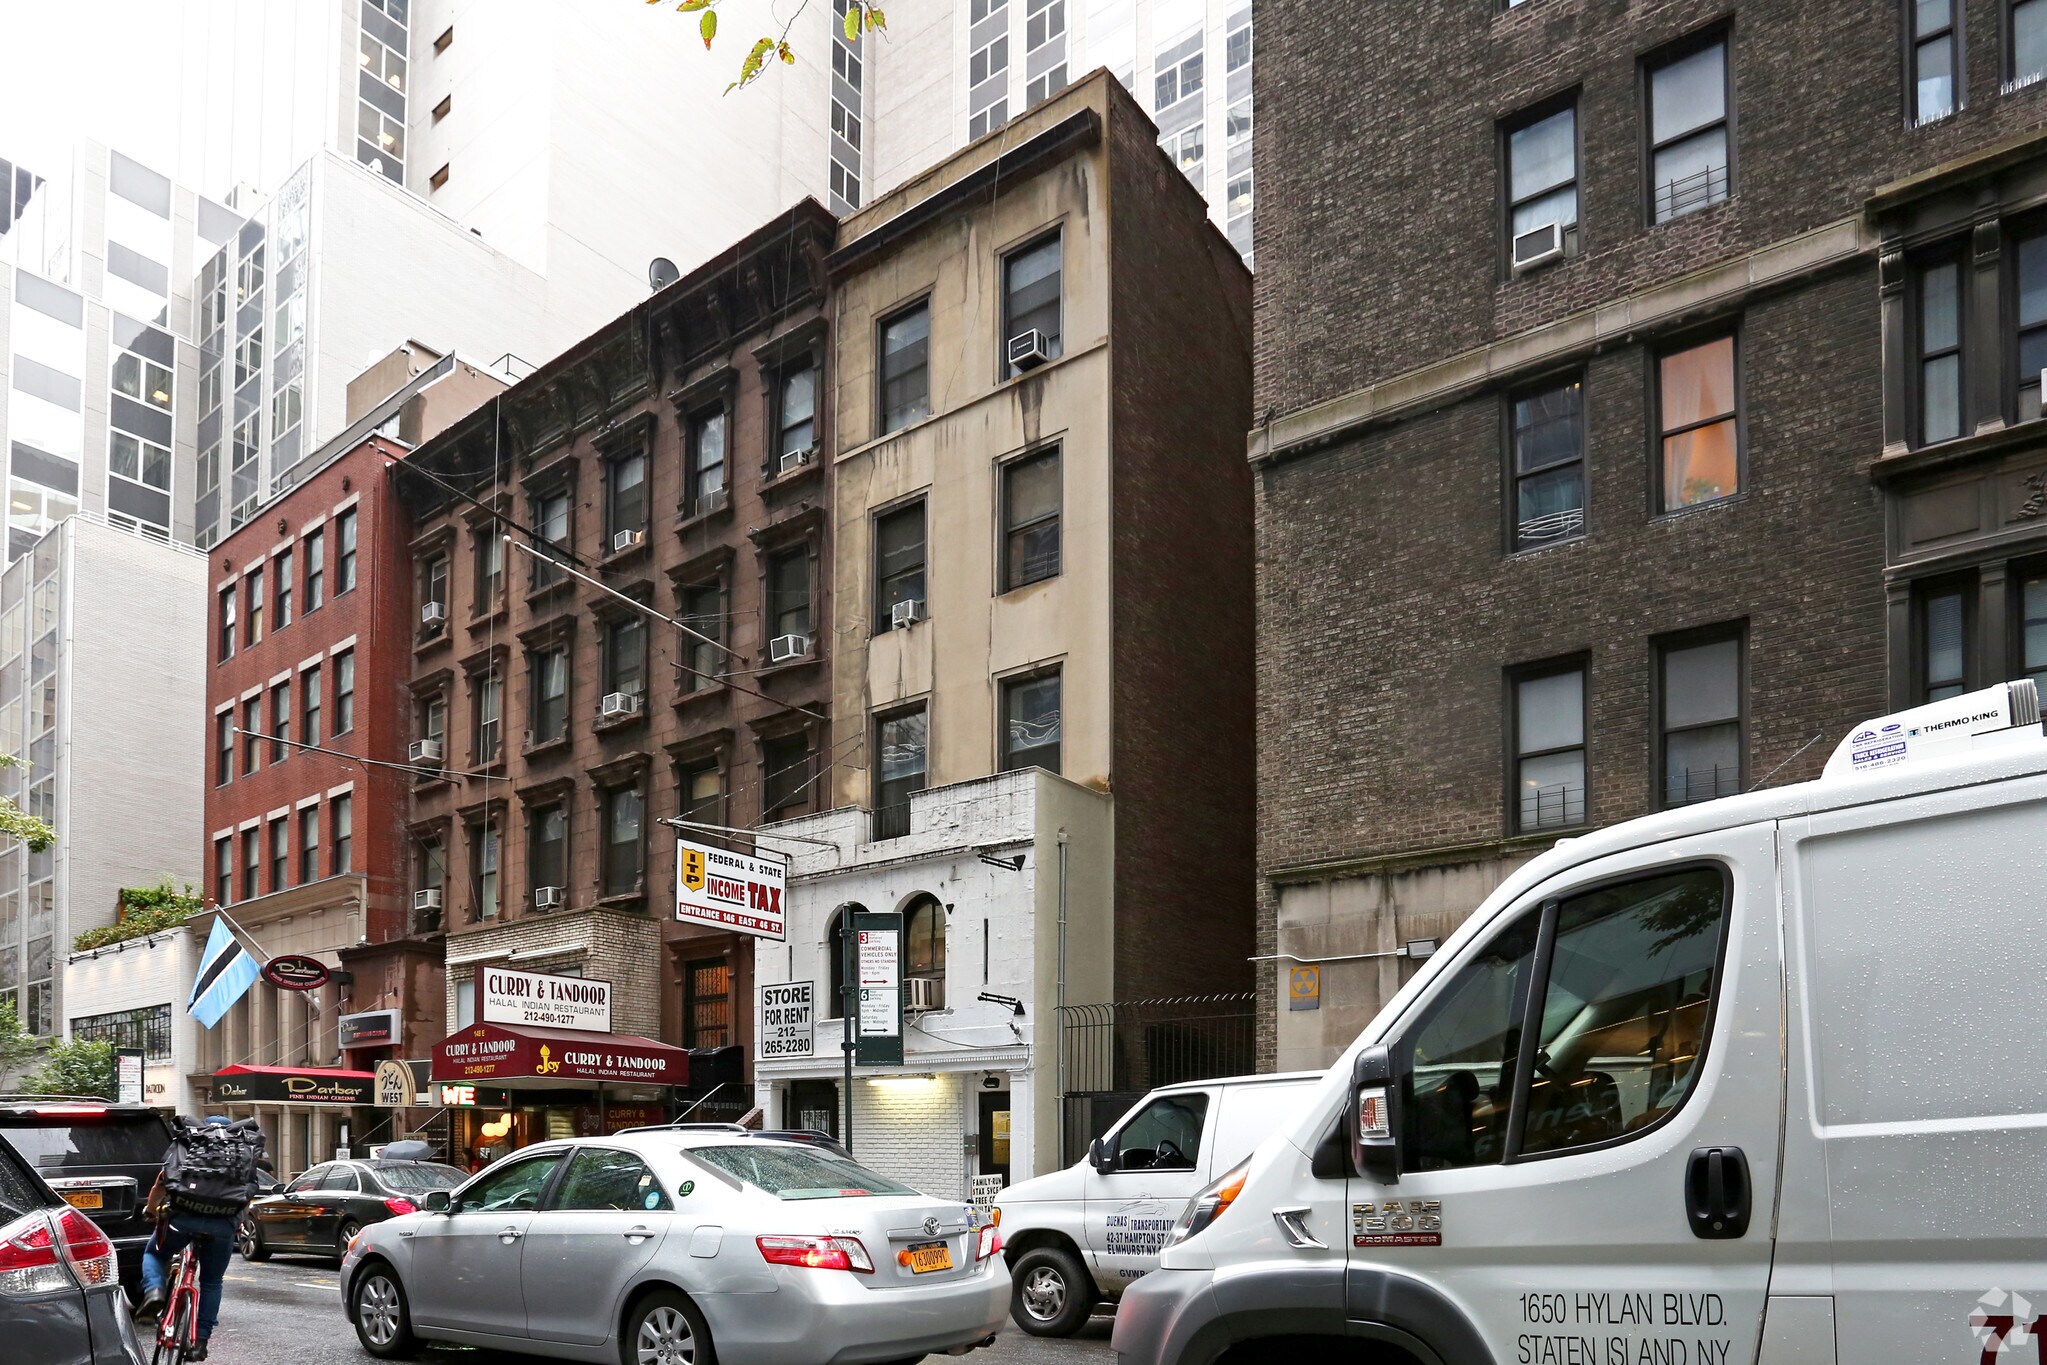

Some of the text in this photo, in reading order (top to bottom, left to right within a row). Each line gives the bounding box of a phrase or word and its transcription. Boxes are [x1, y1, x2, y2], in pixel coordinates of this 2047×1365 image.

[1924, 710, 1998, 733] THERMO KING
[708, 852, 782, 878] FEDERAL & STATE
[707, 877, 781, 914] INCOME TAX
[680, 903, 781, 932] ENTRANCE 146 EAST 46 ST.
[860, 933, 868, 943] 3
[489, 974, 606, 1006] CURRY & TANDOOR
[764, 986, 811, 1006] STORE
[861, 990, 868, 1001] 6
[489, 997, 606, 1016] HALAL INDIAN RESTAURANT
[524, 1010, 575, 1025] 212-490-1277
[765, 1006, 810, 1026] FOR RENT
[777, 1026, 796, 1037] 212
[445, 1039, 516, 1057] CURRY & TANDOOR
[764, 1038, 810, 1054] 265-2280
[480, 1054, 508, 1062] RESTAURANT
[564, 1052, 666, 1071] CURRY & TANDOOR
[464, 1064, 495, 1075] 212-490-1277
[576, 1067, 596, 1075] HALAL
[619, 1070, 656, 1078] RESTAURANT
[219, 1083, 247, 1096] Darbar
[281, 1077, 363, 1096] Darbar
[381, 1092, 403, 1103] WEST
[441, 1085, 476, 1106] WE
[608, 1109, 645, 1119] CURRY &
[606, 1121, 646, 1131] TANDOOR
[972, 1177, 1001, 1186] FAMILY-RUN
[176, 1196, 236, 1215] CHROME
[1106, 1232, 1123, 1243] 42-37
[1124, 1233, 1156, 1244] HAMPTON
[912, 1250, 948, 1267] T630099C
[1107, 1244, 1157, 1256] ELMHURST NY
[1519, 1293, 1727, 1326] 1650 HYLAN BLVD.
[1518, 1334, 1731, 1365] STATEN ISLAND NY
